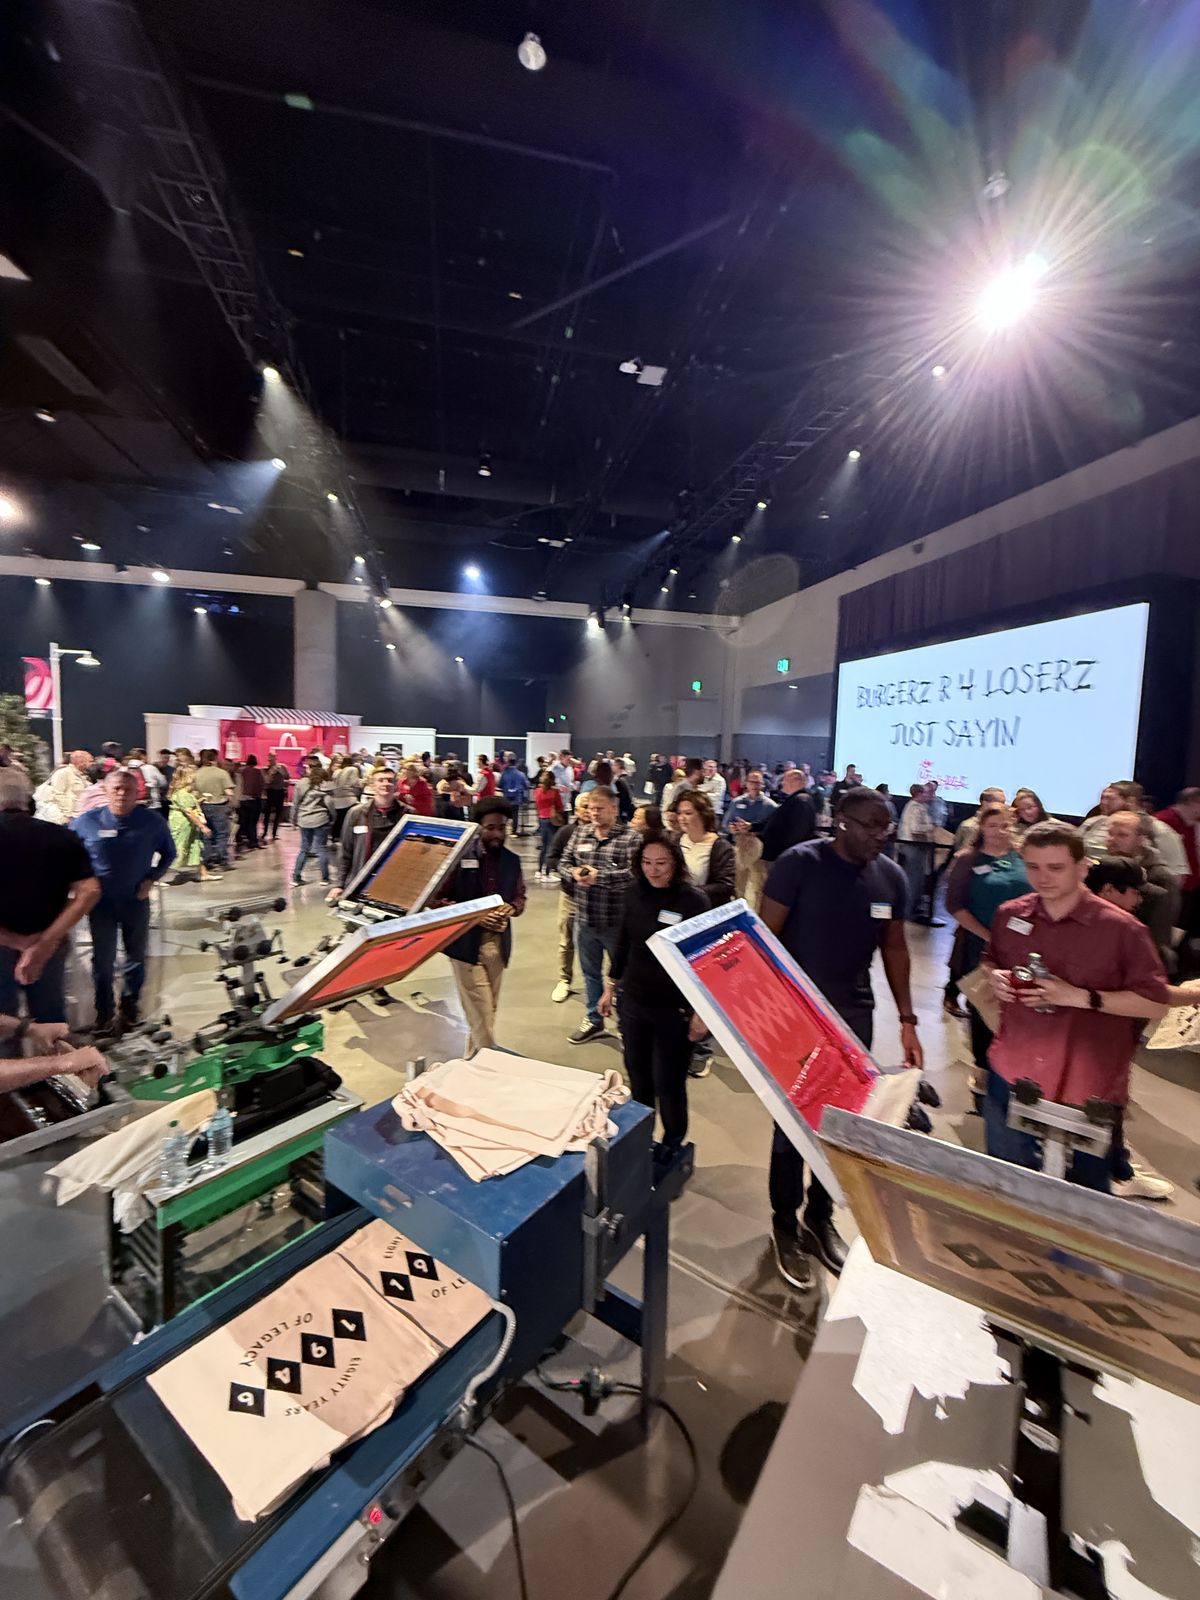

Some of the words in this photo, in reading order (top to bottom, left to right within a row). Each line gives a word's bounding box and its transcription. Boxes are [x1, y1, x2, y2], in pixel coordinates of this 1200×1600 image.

[856, 680, 933, 708] BURGERZ
[939, 675, 952, 702] R
[957, 668, 976, 700] 4
[982, 659, 1099, 697] LOSERZ
[890, 720, 939, 746] JUST
[942, 716, 1021, 748] SAYIN
[431, 1286, 448, 1298] OF
[294, 1313, 312, 1326] OF
[239, 1321, 288, 1367] LEGACY
[329, 1357, 361, 1396] EIGHTY
